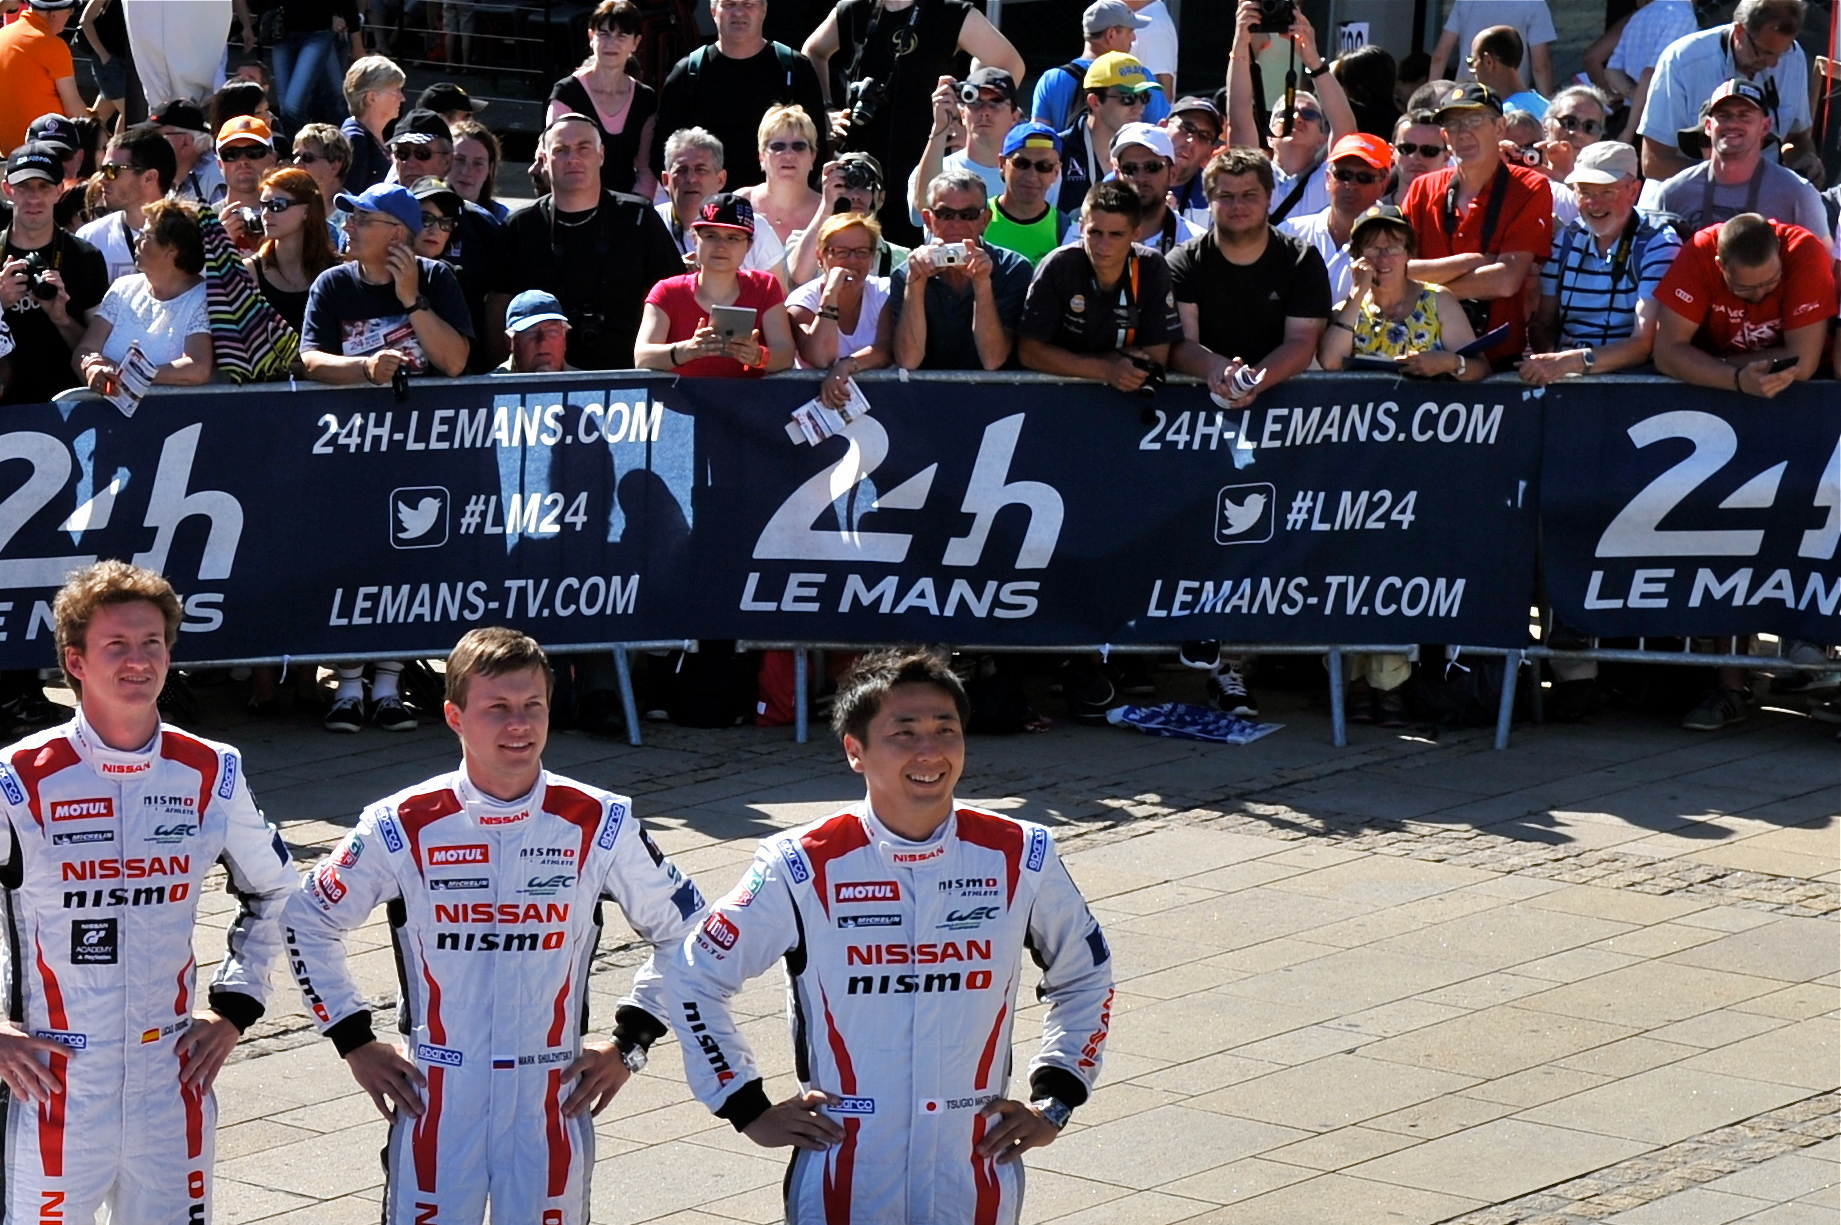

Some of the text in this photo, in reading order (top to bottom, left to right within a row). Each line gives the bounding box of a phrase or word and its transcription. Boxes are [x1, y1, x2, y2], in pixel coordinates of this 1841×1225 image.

[313, 400, 664, 455] 24H-LEMANS.COM
[1139, 400, 1505, 451] 24H-LEMANS.COM
[460, 490, 589, 537] #LM24
[1286, 488, 1417, 534] #LM24
[329, 573, 641, 627] LEMANS-TV.COM
[739, 571, 1041, 620] LE MANS
[1147, 576, 1466, 620] LEMANS-TV.COM
[1583, 567, 1841, 616] LE MAN
[102, 760, 151, 775] NISSAN
[54, 802, 108, 819] MOTUL
[144, 795, 194, 807] nismo
[479, 810, 529, 826] NISSAN
[153, 824, 198, 837] WEC
[432, 847, 485, 865] MOTUL
[520, 848, 575, 859] nismo
[892, 845, 945, 863] NISSAN
[62, 854, 191, 882] NISSAN
[526, 875, 577, 889] WEC
[838, 885, 894, 900] MOTUL
[938, 877, 998, 891] nismo
[62, 883, 190, 909] nismo
[434, 902, 570, 924] NISSAN
[945, 906, 1001, 922] WEC
[75, 946, 113, 954] ACADEMY
[435, 930, 565, 952] nismo
[846, 940, 992, 967] NISSAN
[286, 926, 331, 1023] nismo
[847, 970, 992, 996] nismo
[419, 1045, 461, 1063] sparco
[682, 1001, 739, 1088] nismo
